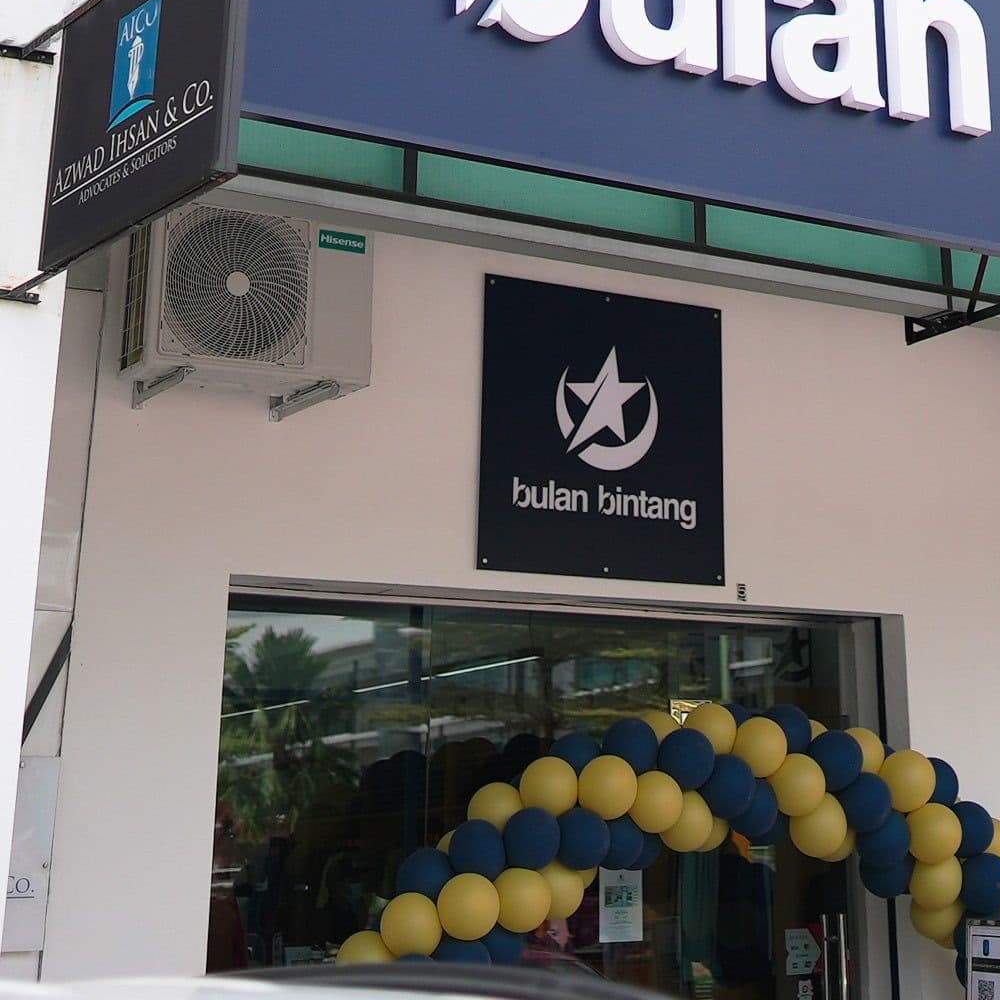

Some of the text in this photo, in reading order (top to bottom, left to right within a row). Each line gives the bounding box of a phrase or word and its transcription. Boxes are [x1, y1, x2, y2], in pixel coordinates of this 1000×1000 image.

[53, 80, 214, 198] AZWAD IHSAN & CO.
[78, 169, 122, 206] ADVOCATES
[130, 135, 178, 174] SOLICITORS
[320, 233, 364, 249] Hisense
[512, 476, 697, 530] bulan bintang
